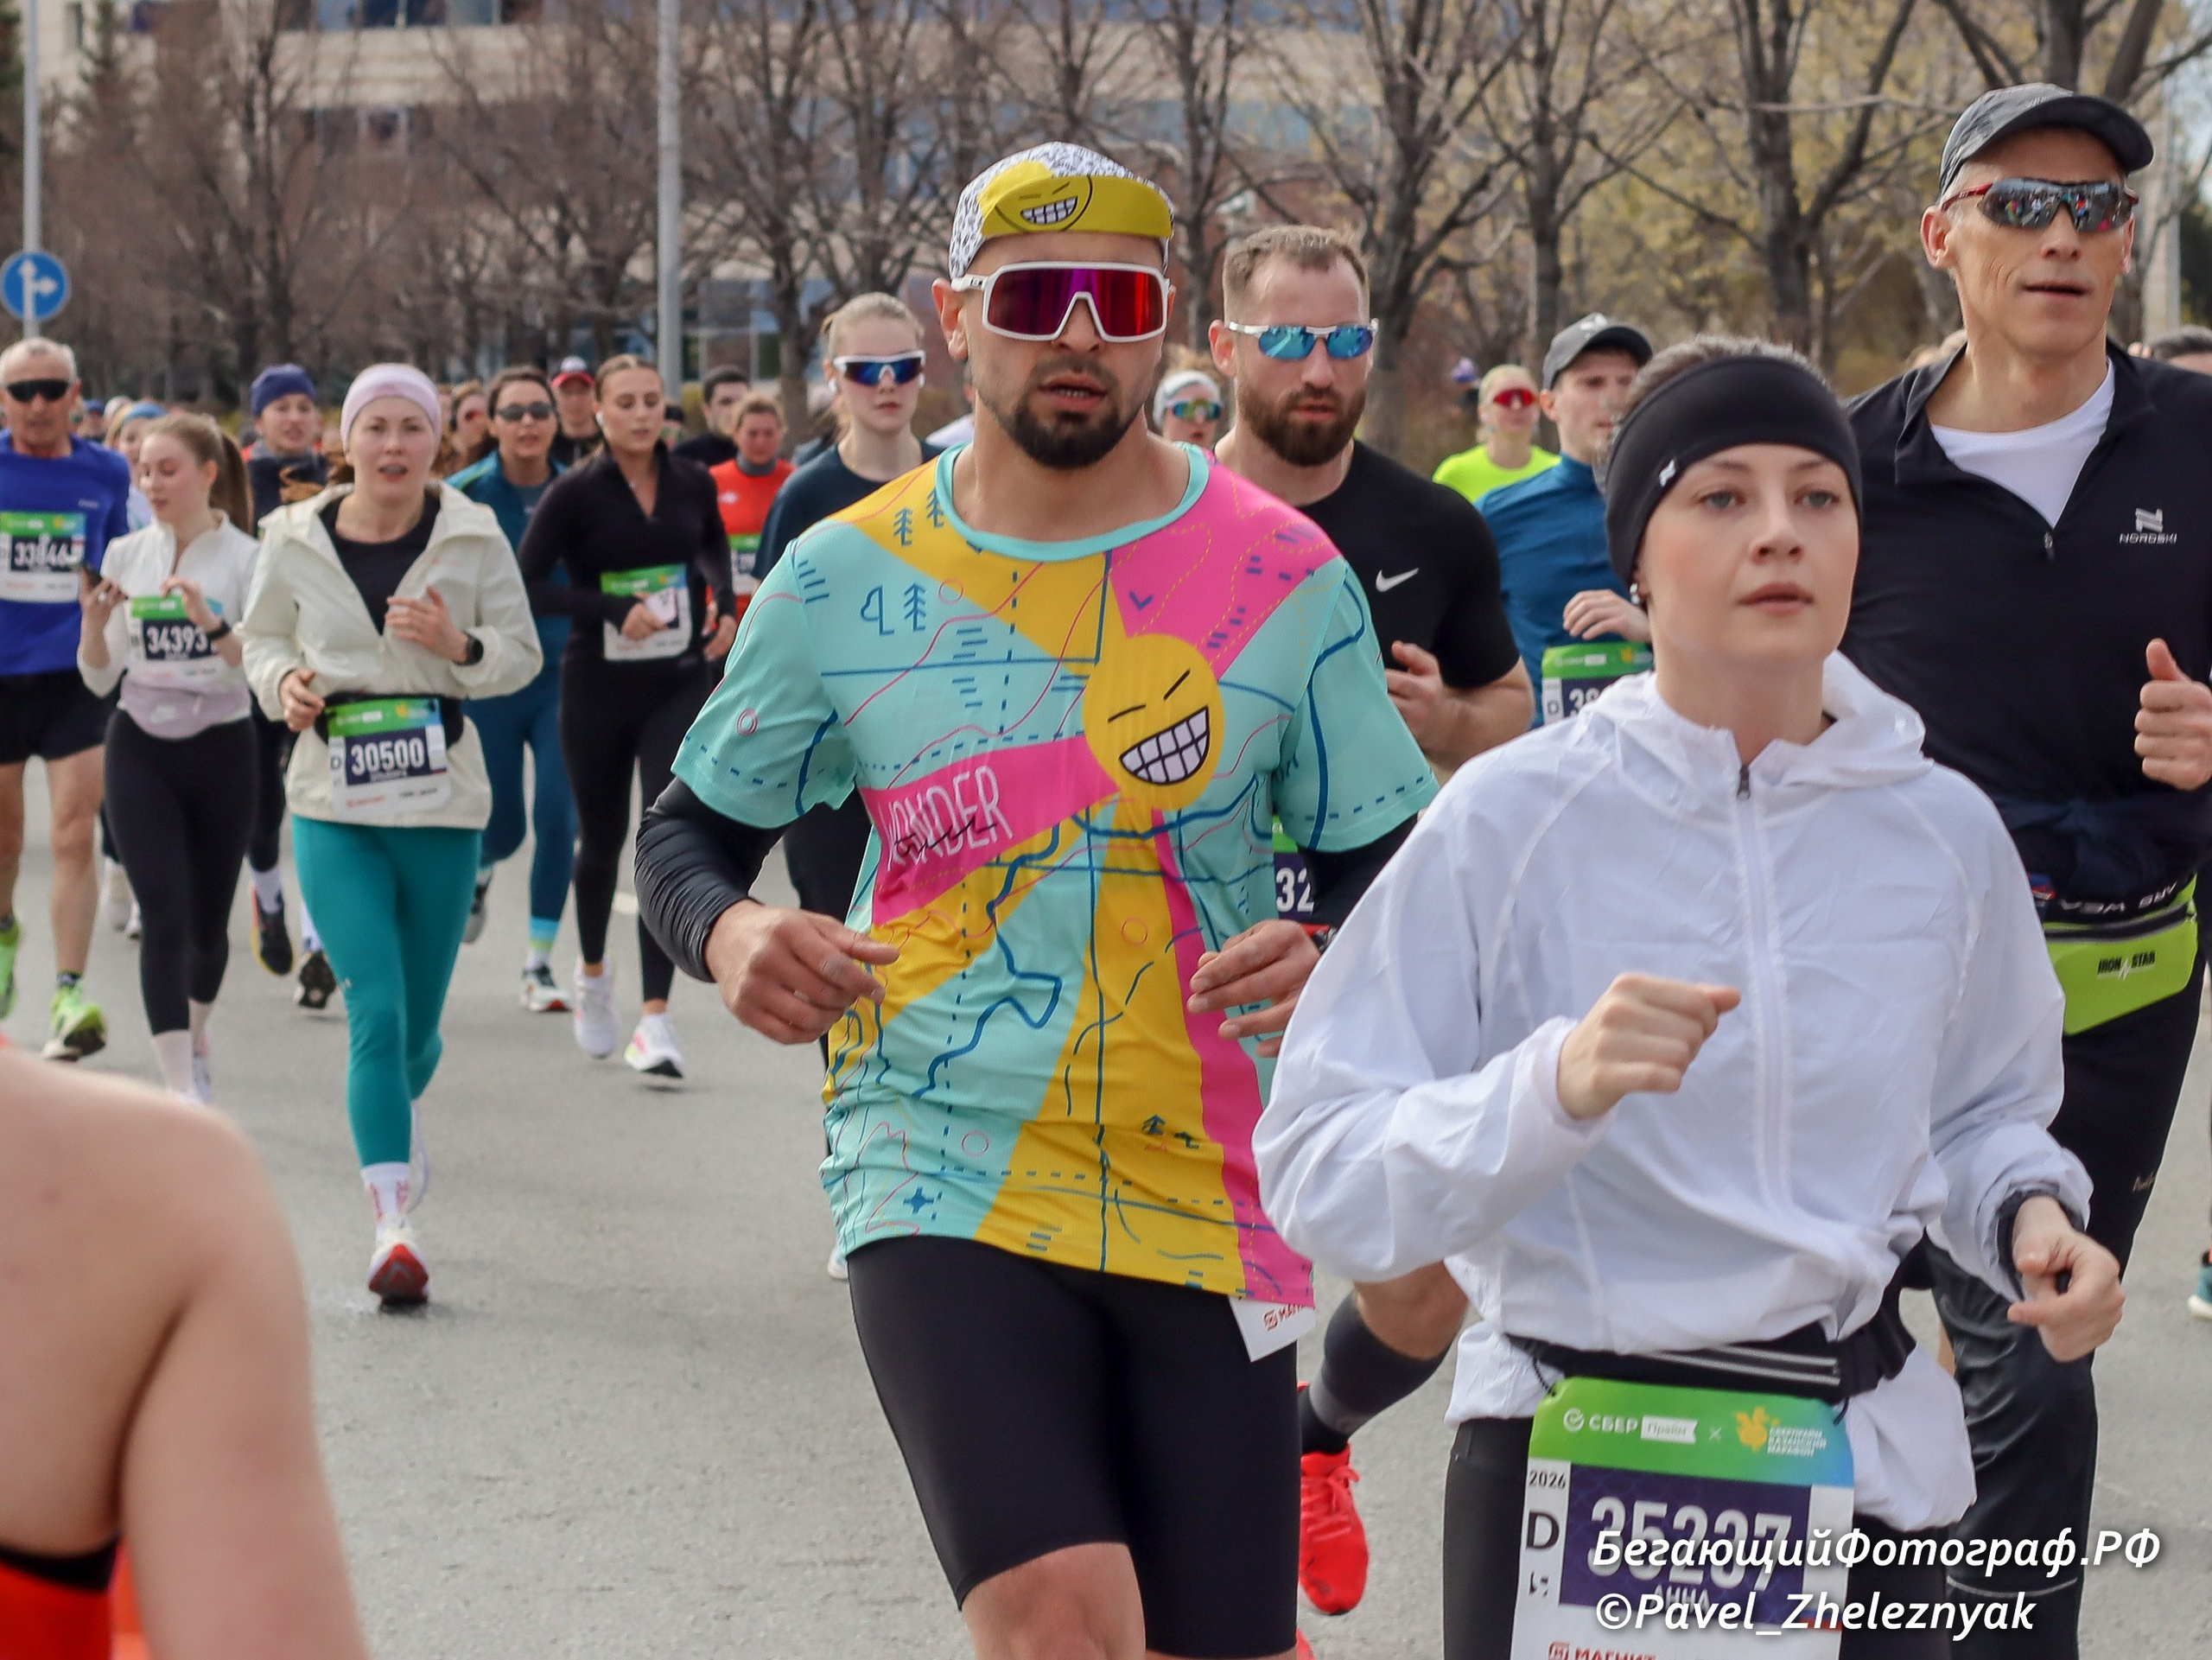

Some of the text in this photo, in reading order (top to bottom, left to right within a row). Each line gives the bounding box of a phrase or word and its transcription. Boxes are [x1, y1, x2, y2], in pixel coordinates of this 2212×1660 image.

[350, 737, 425, 776] 30500
[2131, 950, 2156, 969] STAR
[1528, 1470, 1567, 1490] 2026
[1525, 1509, 1560, 1550] D
[1586, 1496, 1793, 1593] 35237
